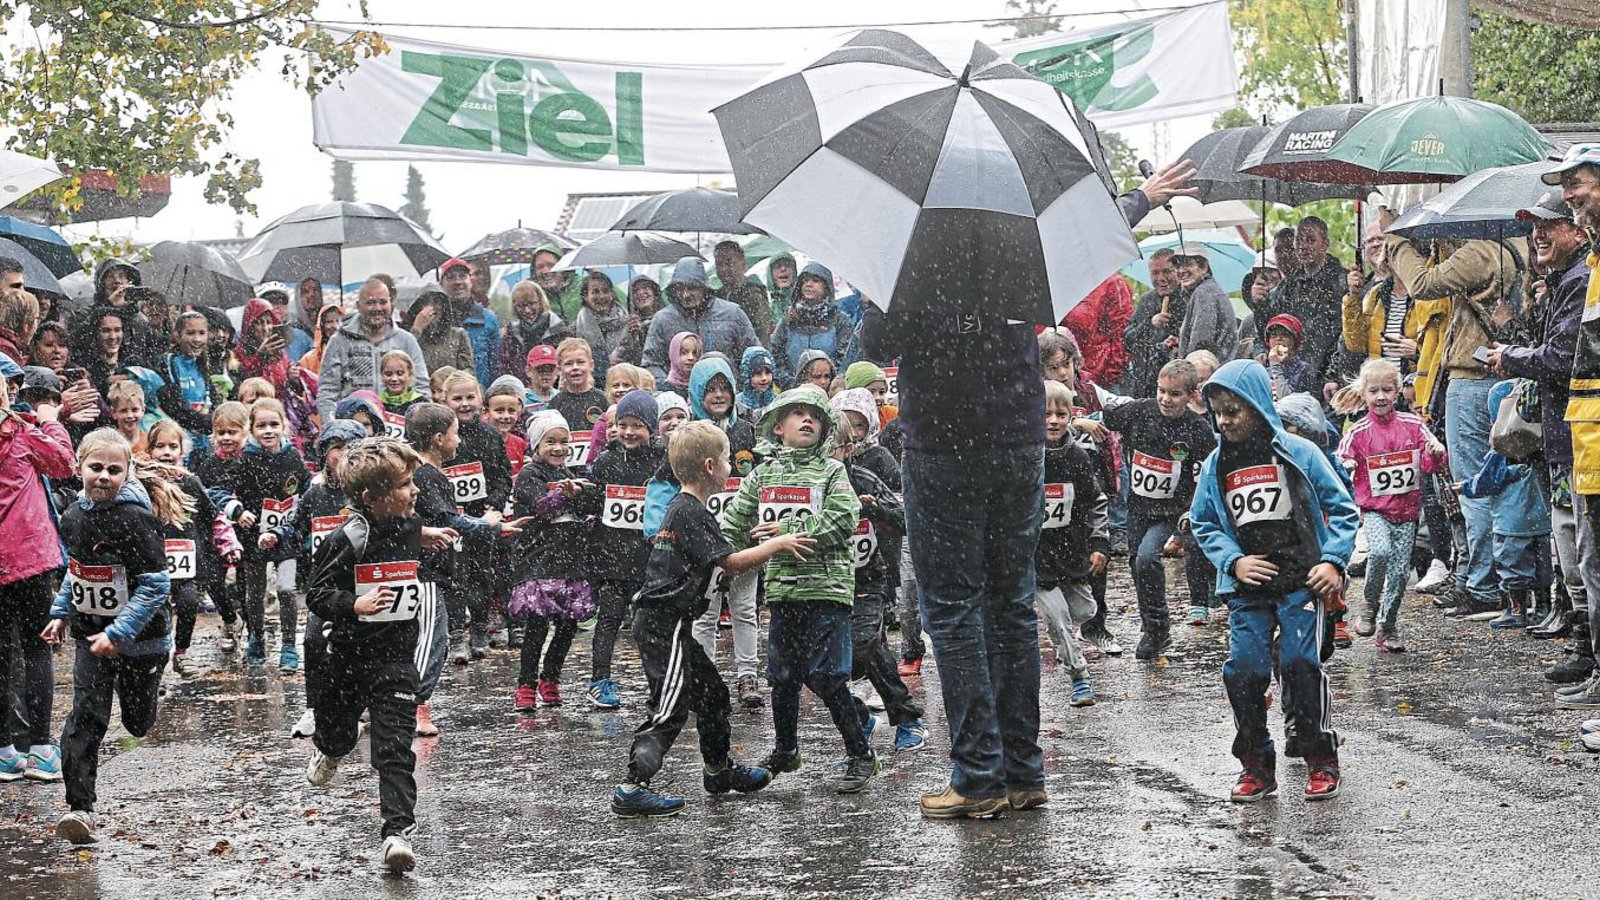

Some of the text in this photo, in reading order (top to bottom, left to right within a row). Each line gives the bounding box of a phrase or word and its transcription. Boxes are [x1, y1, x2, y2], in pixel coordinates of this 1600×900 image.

[400, 50, 645, 166] Ziel
[1284, 139, 1333, 150] RACING
[1288, 130, 1338, 141] MARTINI
[1410, 139, 1444, 156] JEVER
[450, 478, 481, 497] 89
[1133, 469, 1172, 494] 904
[1242, 474, 1275, 484] Sparkasse
[1376, 467, 1415, 491] 932
[1231, 487, 1282, 520] 967
[72, 581, 119, 610] 918
[389, 584, 422, 614] 73
